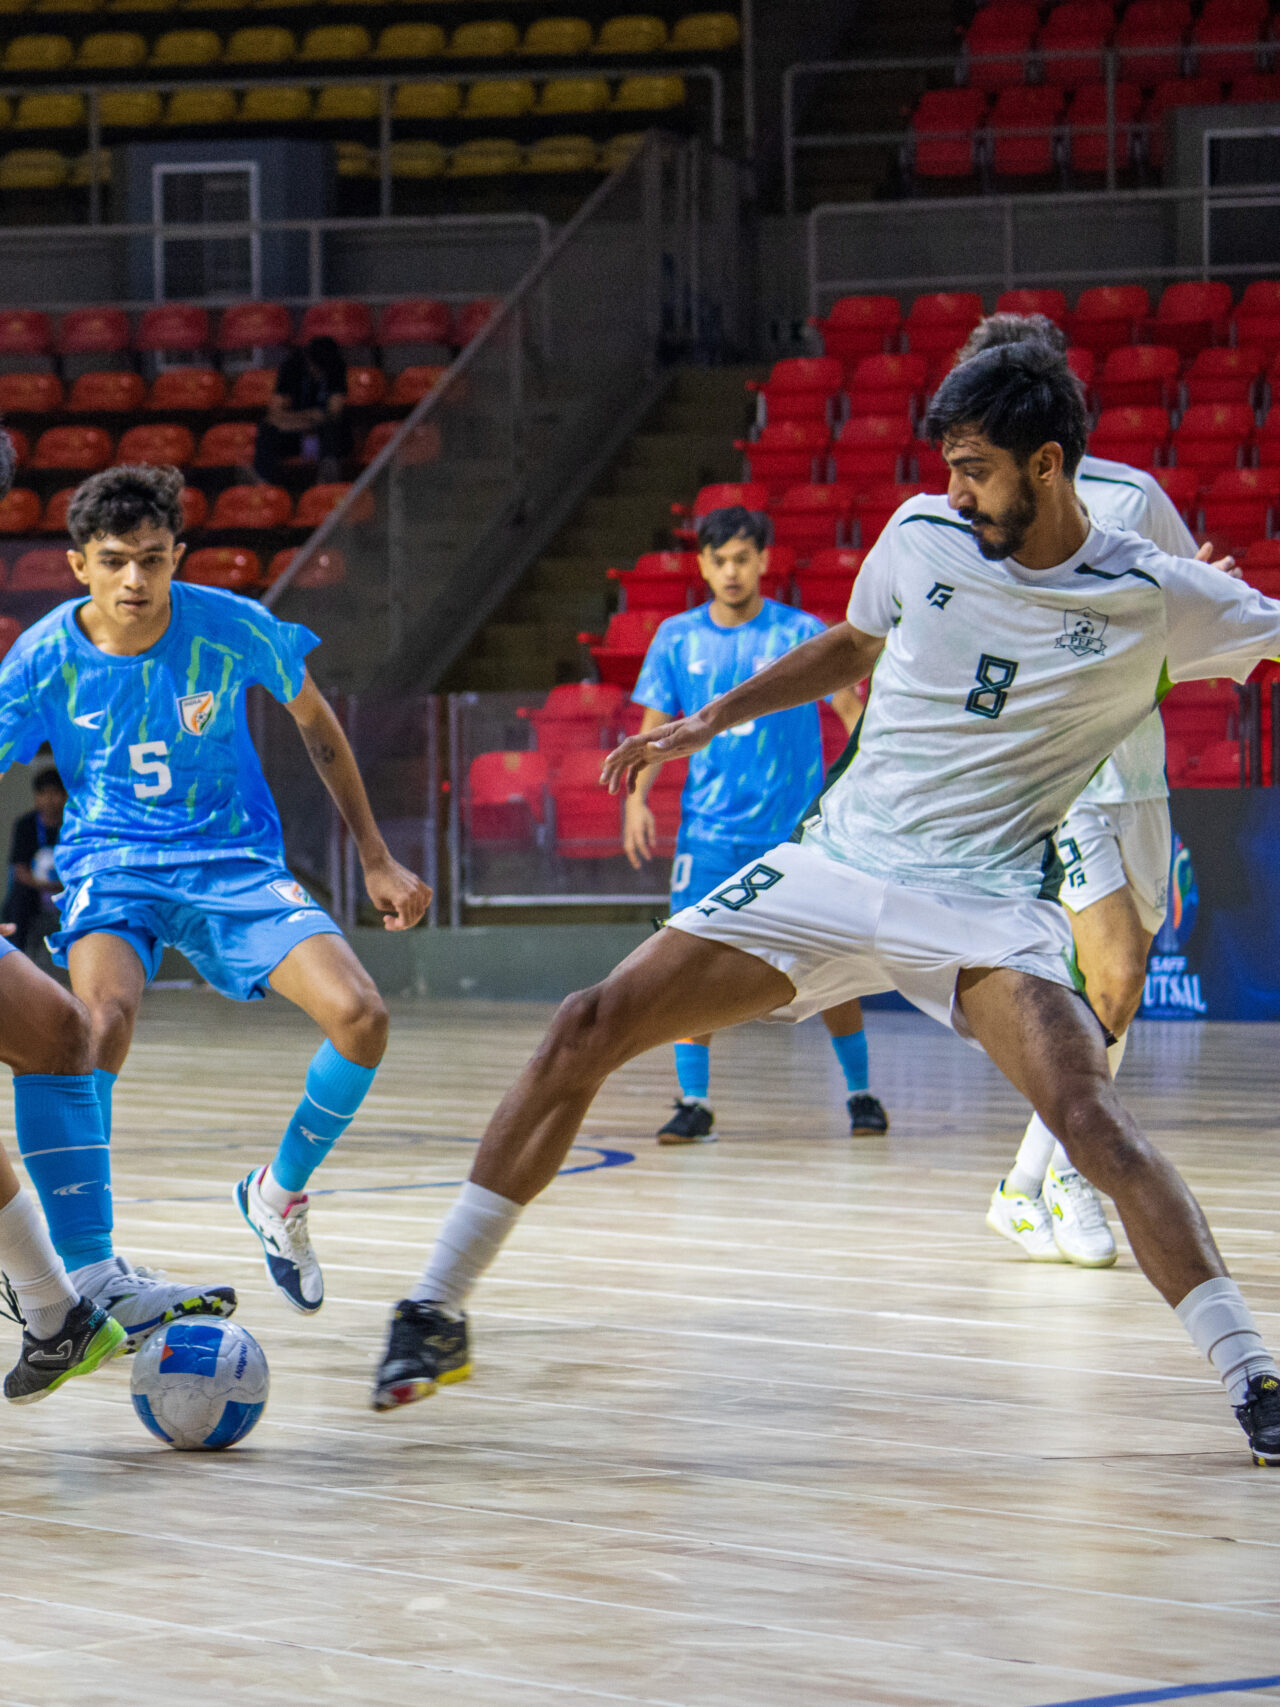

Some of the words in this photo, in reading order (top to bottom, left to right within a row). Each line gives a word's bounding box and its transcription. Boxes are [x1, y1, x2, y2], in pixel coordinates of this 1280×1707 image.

[965, 653, 1019, 720] 8
[128, 740, 173, 799] 5
[709, 863, 785, 911] 8
[1144, 973, 1207, 1014] UTSAL
